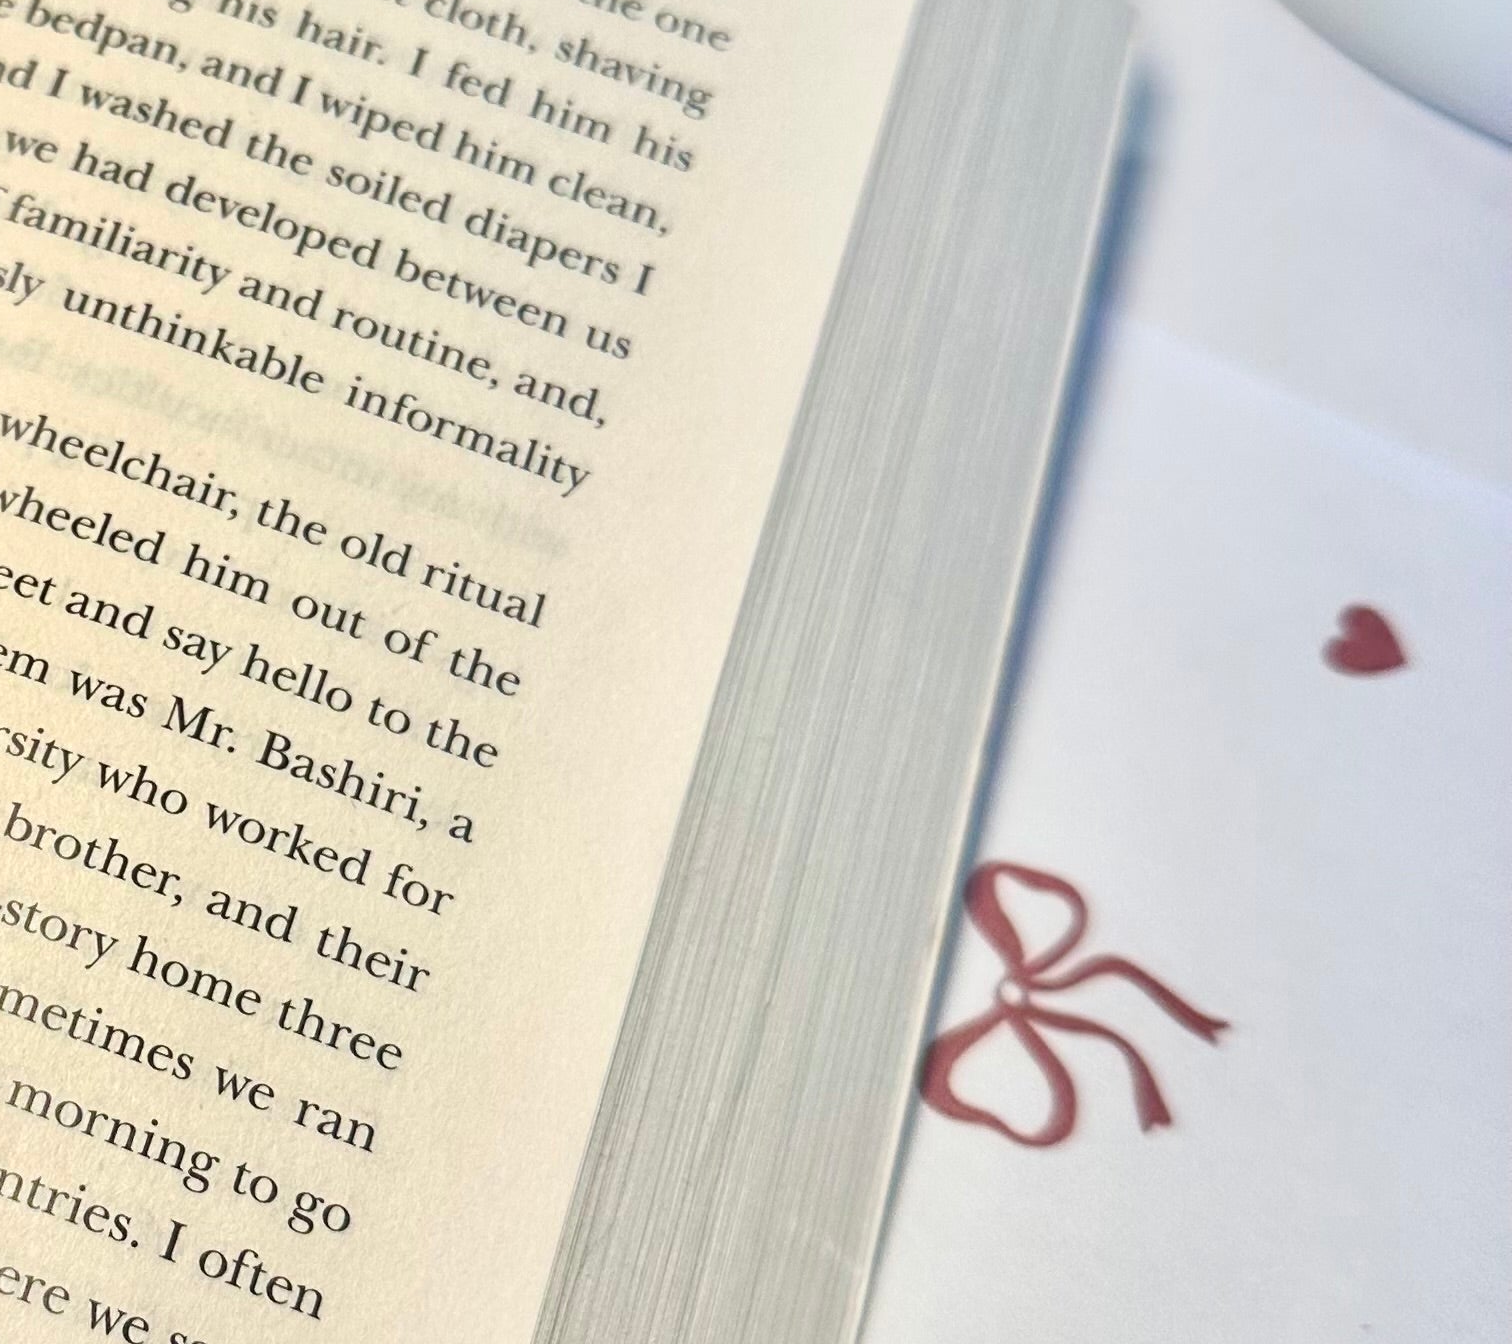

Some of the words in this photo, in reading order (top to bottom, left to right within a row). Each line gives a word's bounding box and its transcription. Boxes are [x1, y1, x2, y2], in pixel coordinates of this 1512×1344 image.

[559, 38, 714, 119] shaving
[49, 68, 68, 97] I
[82, 85, 233, 148] washed
[246, 133, 313, 175] the
[327, 166, 452, 223] soiled
[465, 208, 619, 283] diapers
[635, 265, 655, 295] I
[64, 289, 324, 393] unthinkable
[345, 386, 591, 498] informality
[1, 414, 237, 519] wheelchair,
[258, 499, 327, 545] the
[341, 533, 412, 577] old
[422, 562, 546, 628] ritual
[66, 592, 154, 639] and
[163, 627, 232, 674] say
[241, 644, 352, 712] hello
[369, 698, 410, 734] to
[427, 719, 498, 768] the
[71, 671, 147, 717] was
[162, 696, 234, 753] Mr.
[257, 731, 427, 830] Bashiri,
[449, 815, 472, 843] a
[4, 802, 182, 906] brother,
[206, 891, 298, 942] and
[317, 926, 430, 992] their
[99, 762, 187, 814] who
[207, 803, 371, 885] worked
[384, 864, 454, 915] for
[6, 1081, 220, 1193] morning
[234, 1163, 278, 1203] to
[288, 1192, 351, 1234] go
